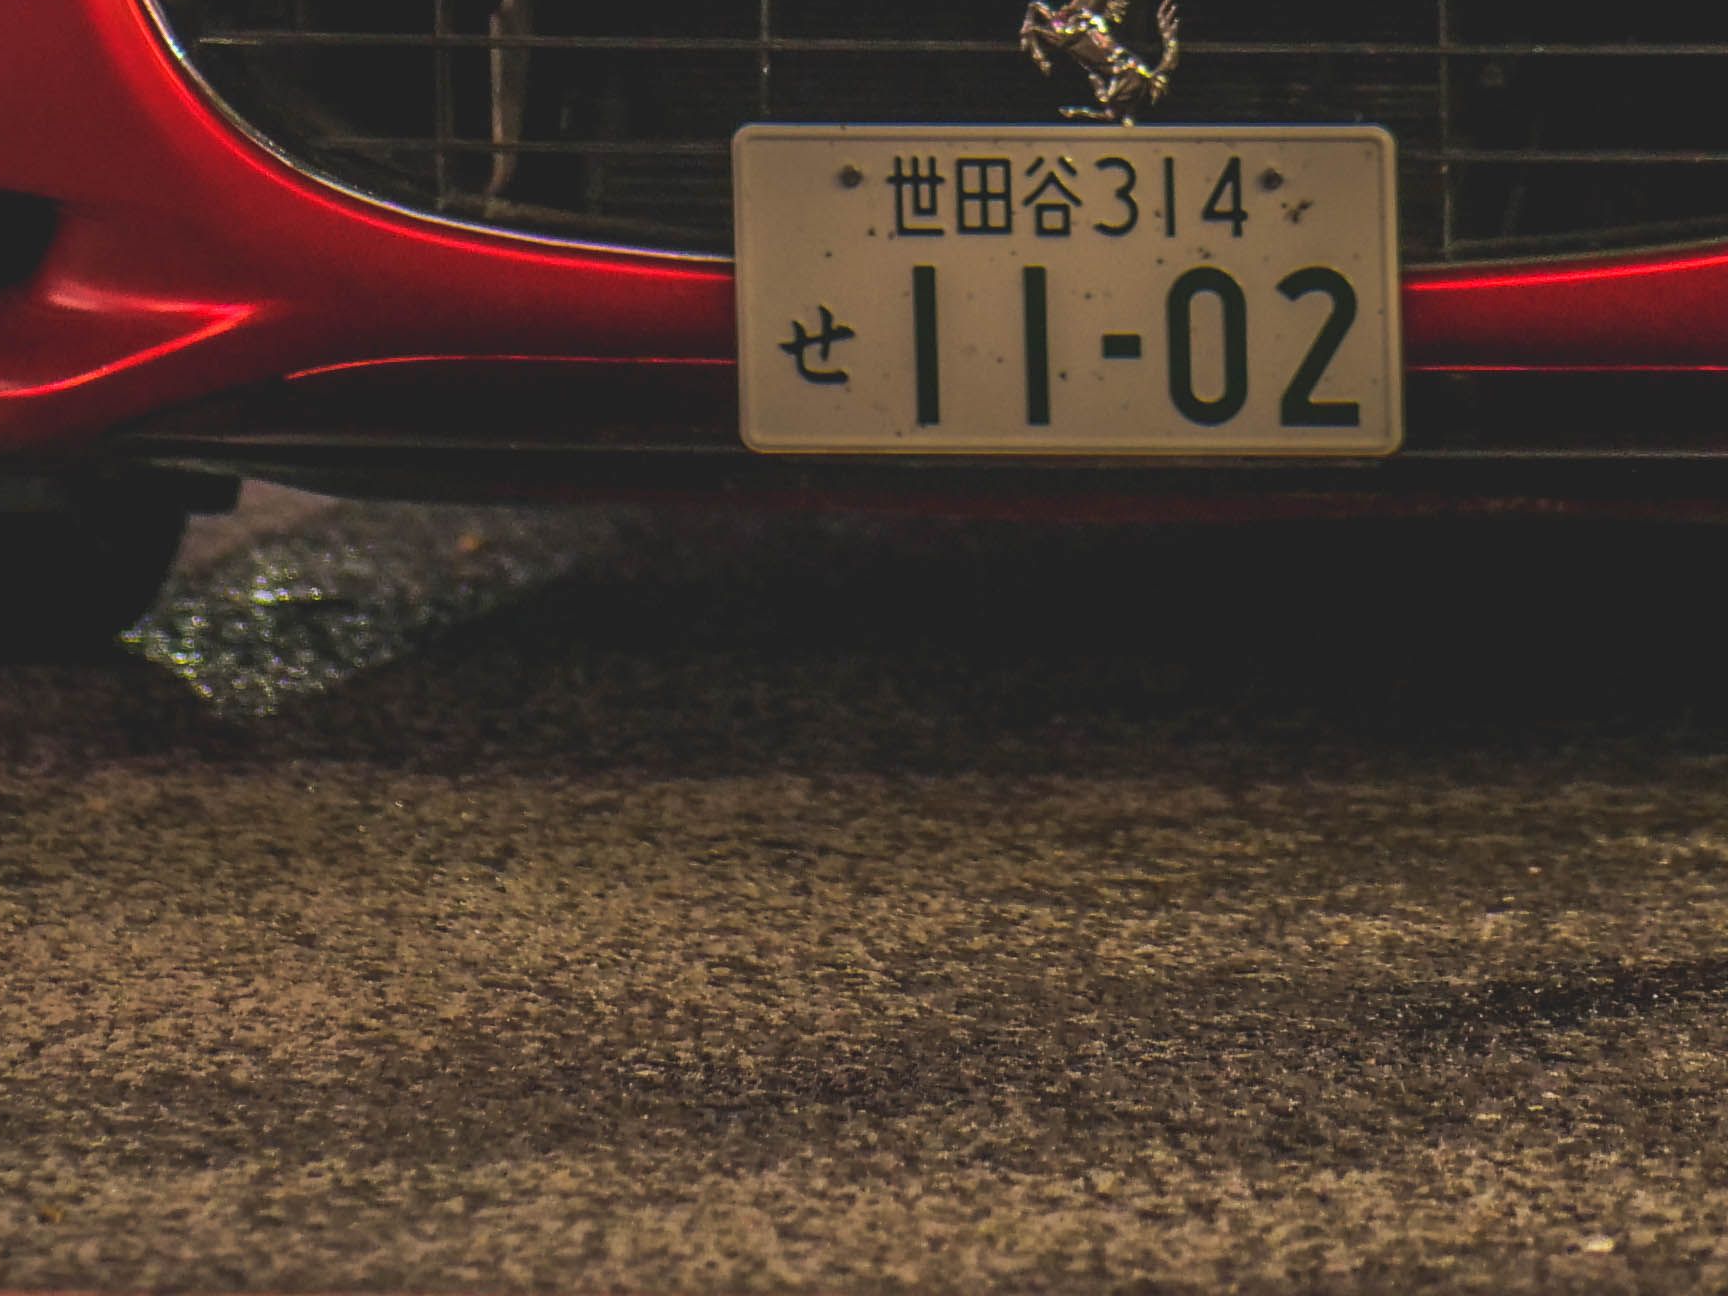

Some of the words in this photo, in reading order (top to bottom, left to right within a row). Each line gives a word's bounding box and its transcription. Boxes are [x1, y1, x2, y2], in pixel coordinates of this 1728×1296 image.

[886, 155, 1249, 238] 世田谷314
[779, 305, 856, 385] せ
[913, 265, 1361, 427] 11-02
